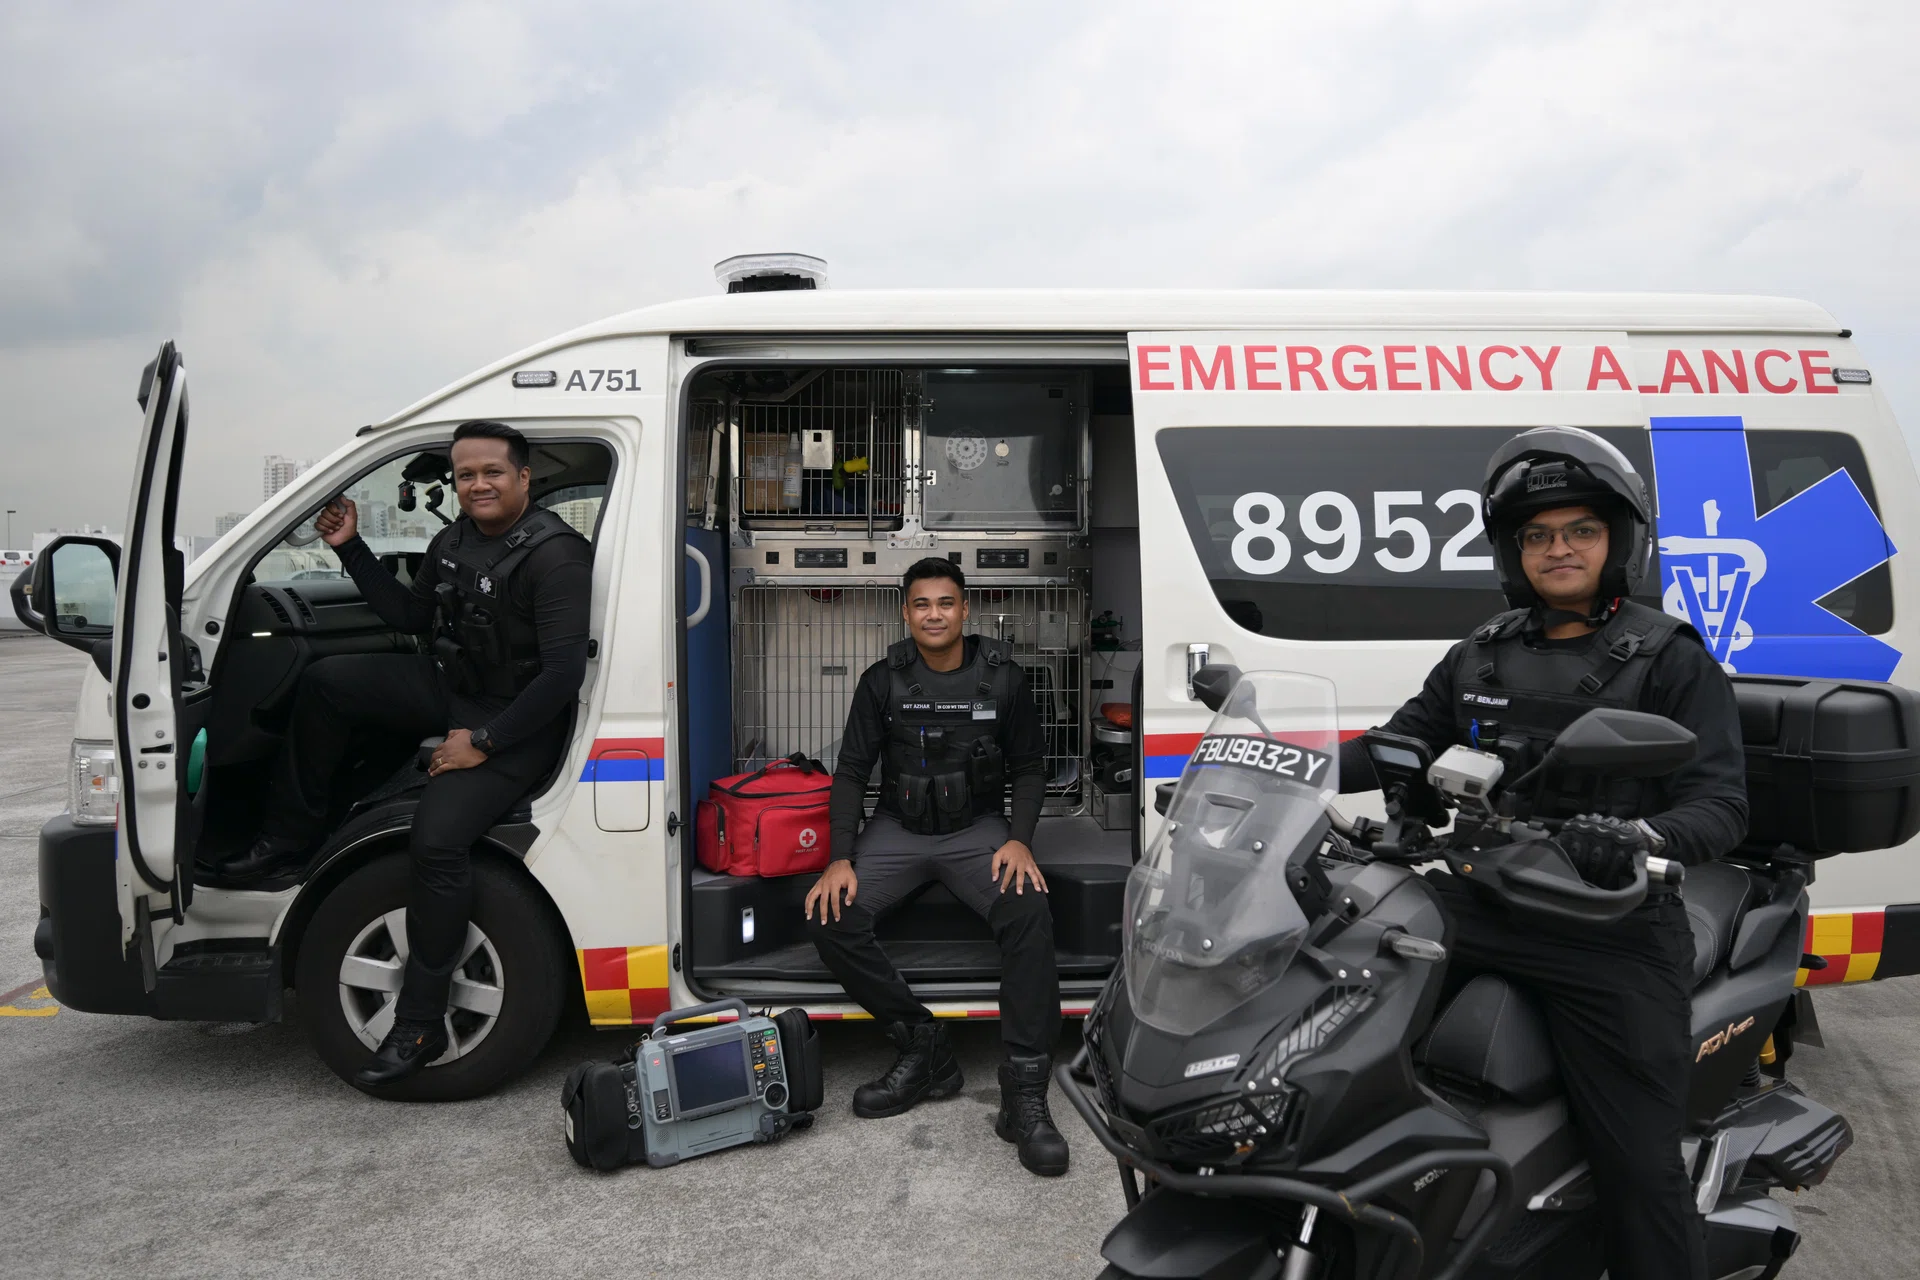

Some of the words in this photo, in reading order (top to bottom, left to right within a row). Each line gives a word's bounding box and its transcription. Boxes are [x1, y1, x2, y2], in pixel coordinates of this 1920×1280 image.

[564, 368, 642, 392] A751
[1136, 344, 1562, 392] EMERGENCY
[1231, 489, 1495, 575] 8952
[1463, 693, 1476, 701] CPT
[1193, 738, 1327, 782] FBU9832Y
